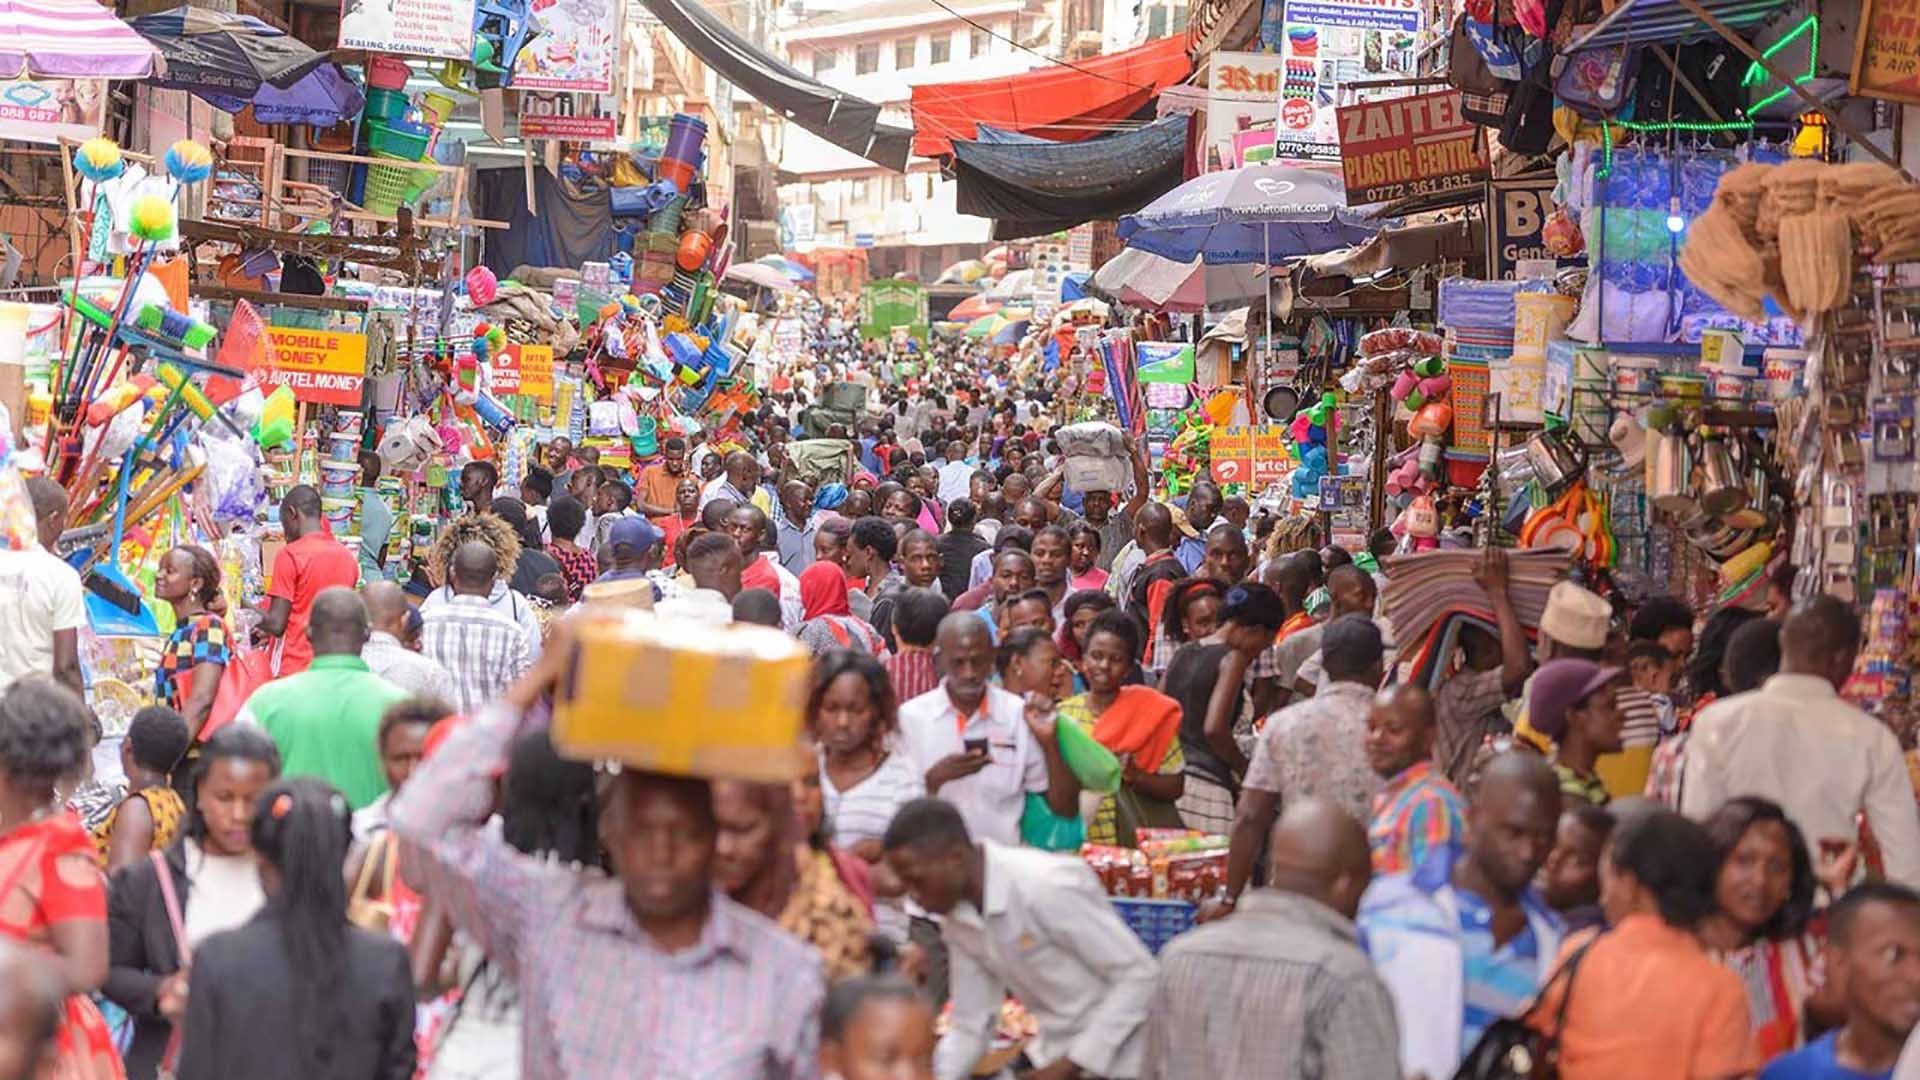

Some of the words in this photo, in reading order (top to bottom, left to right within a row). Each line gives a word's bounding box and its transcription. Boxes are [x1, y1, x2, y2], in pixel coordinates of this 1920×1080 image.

[344, 39, 386, 51] SEALING,
[388, 43, 435, 54] SCANNING
[1344, 147, 1412, 188] PLASTIC
[1415, 136, 1480, 175] CENTRE
[1367, 184, 1405, 202] 0772
[1409, 179, 1437, 196] 361
[1442, 173, 1472, 190] 835
[268, 333, 339, 351] MOBILE
[268, 370, 315, 388] AIRTEL
[314, 373, 364, 391] MONEY
[1255, 458, 1289, 471] irtel
